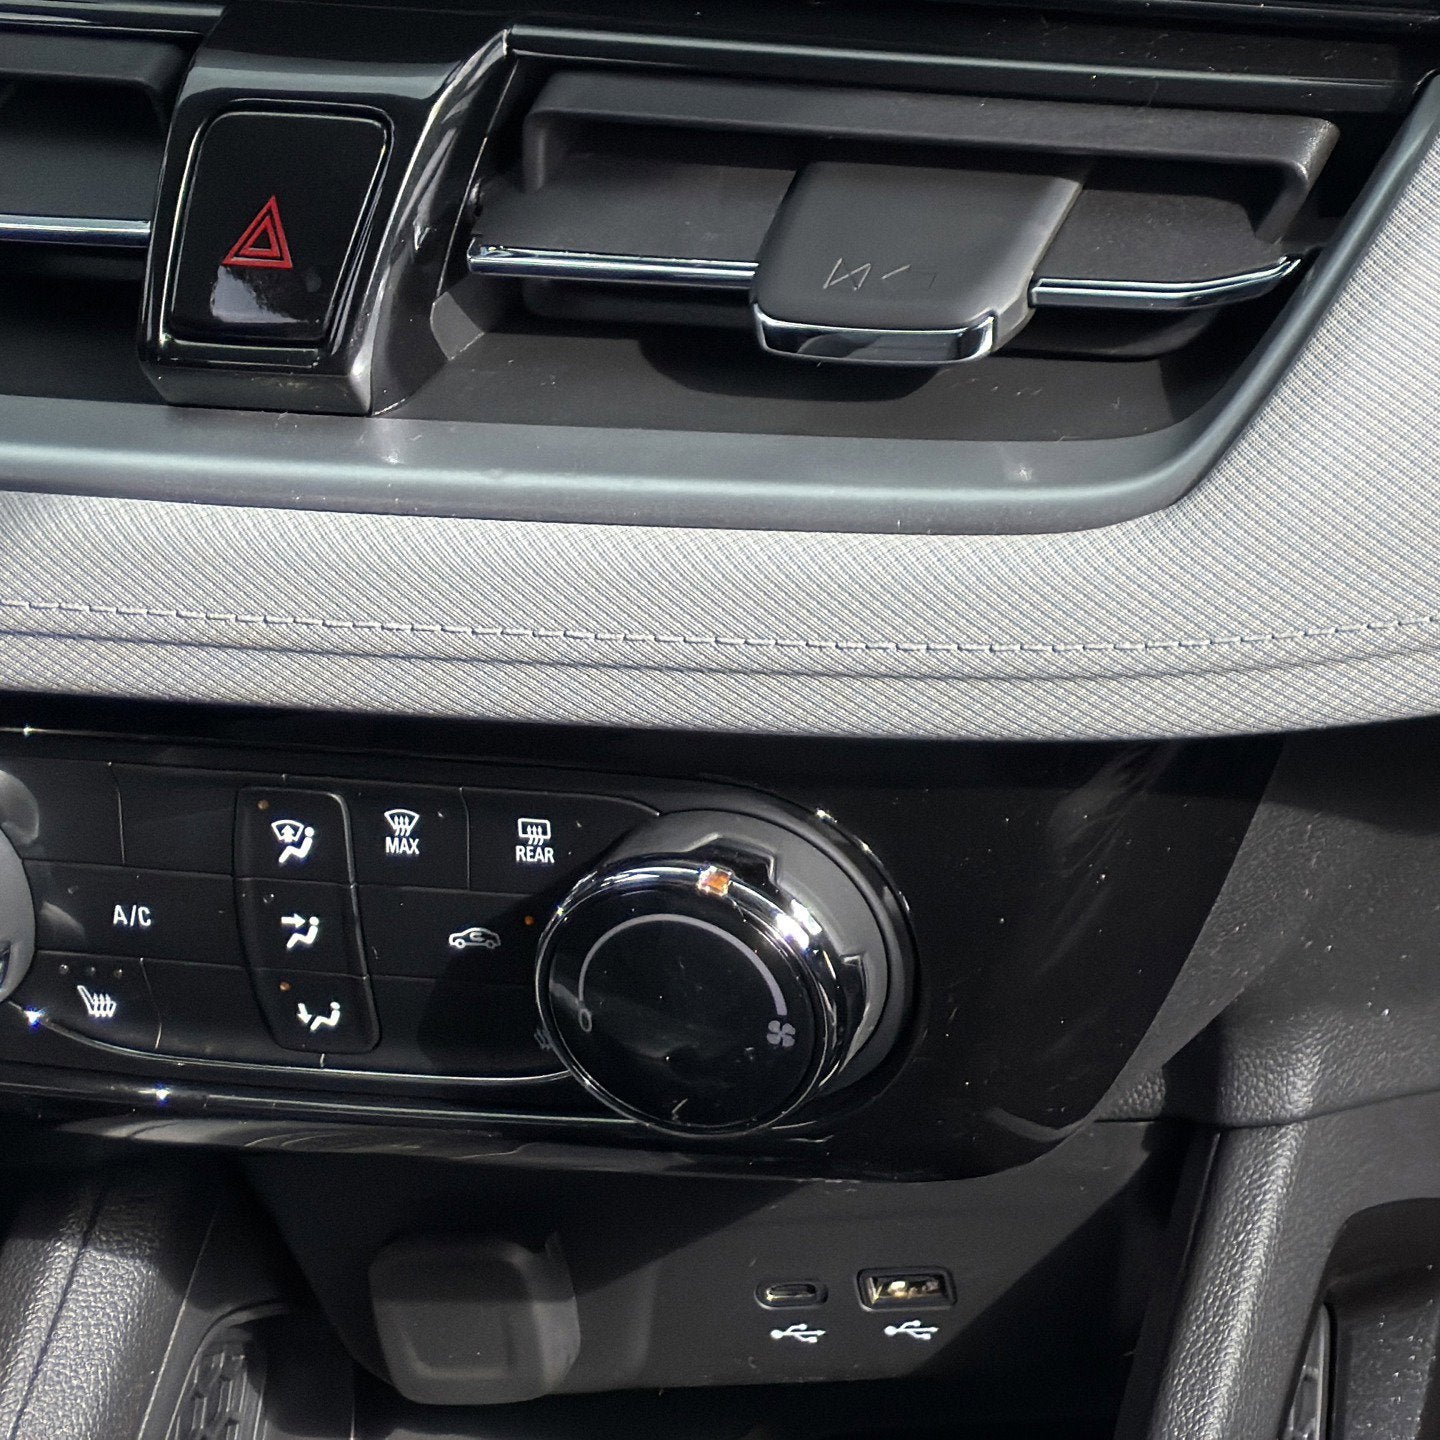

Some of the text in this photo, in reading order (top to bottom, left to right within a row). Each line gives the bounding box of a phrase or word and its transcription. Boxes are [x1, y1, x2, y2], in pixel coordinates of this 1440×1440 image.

[386, 837, 419, 854] MAX
[516, 846, 554, 863] REAR
[113, 905, 151, 926] A/C
